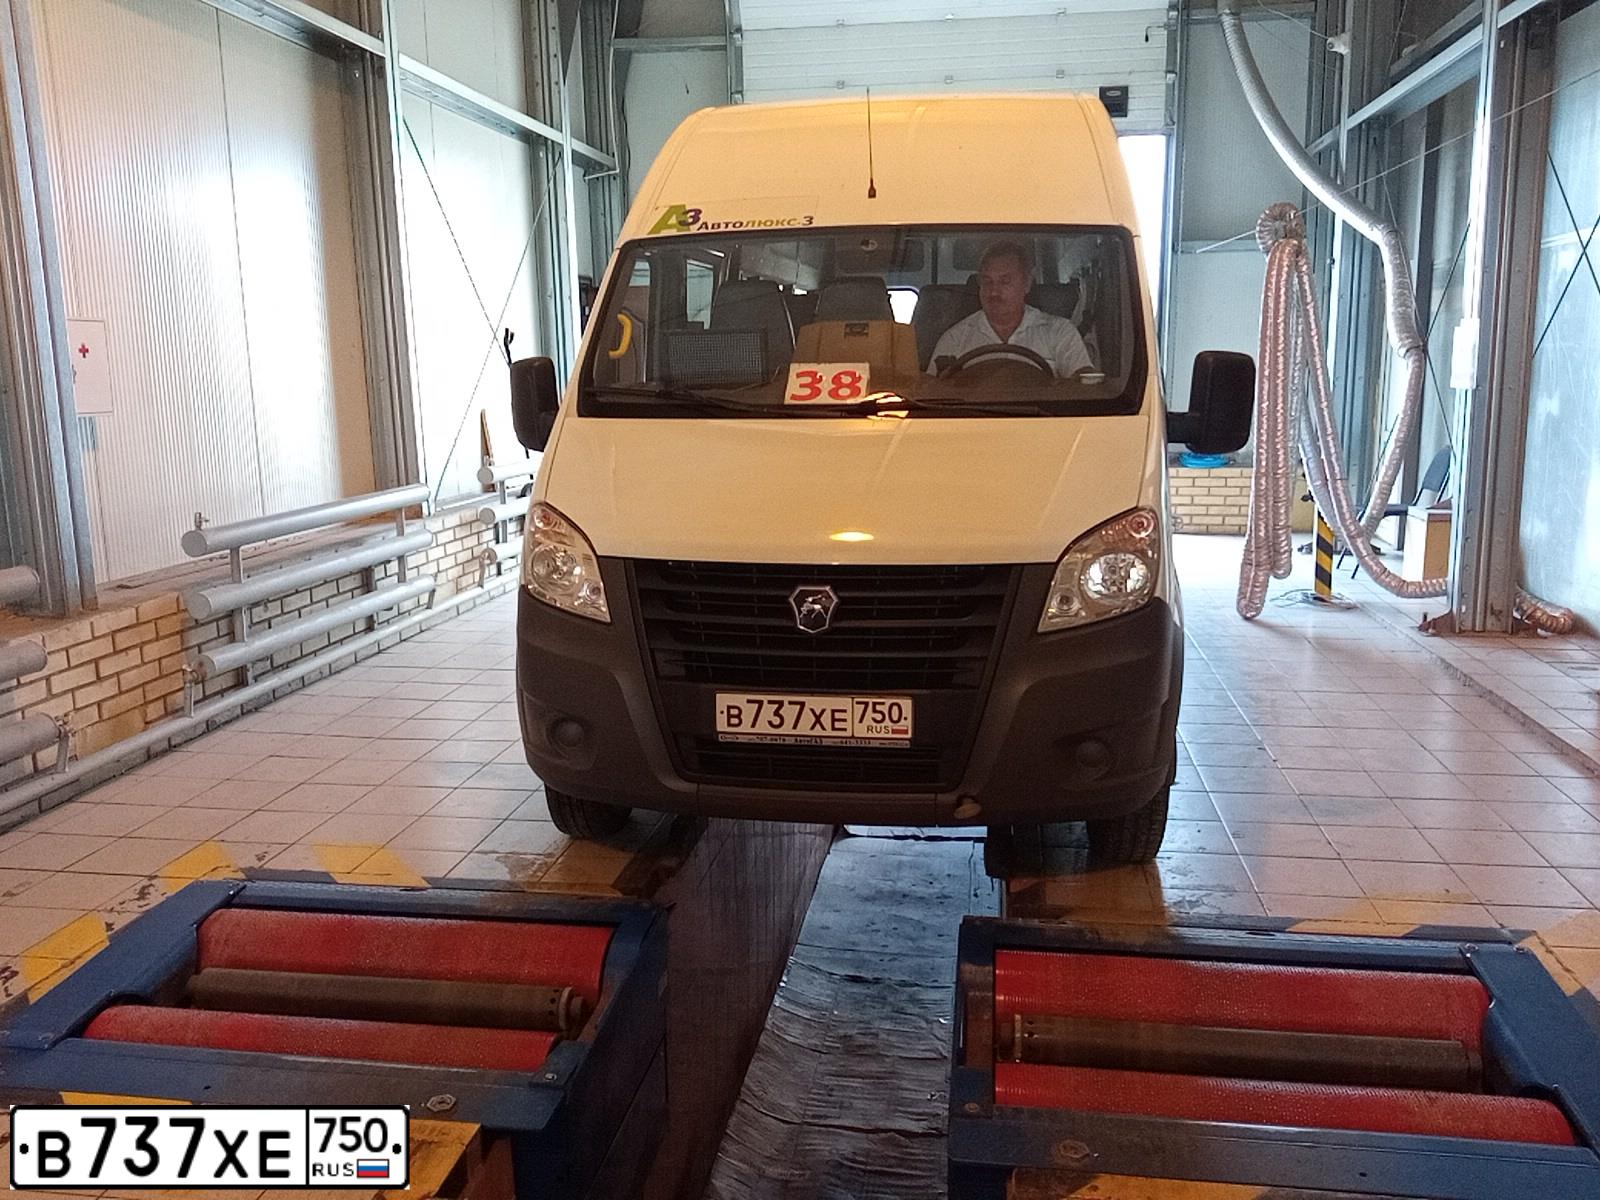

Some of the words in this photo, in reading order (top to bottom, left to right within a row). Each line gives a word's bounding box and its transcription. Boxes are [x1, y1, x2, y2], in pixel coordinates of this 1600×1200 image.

[790, 370, 863, 401] 38
[726, 698, 848, 732] В737ХЕ
[855, 701, 904, 724] 750
[866, 725, 890, 735] RUS
